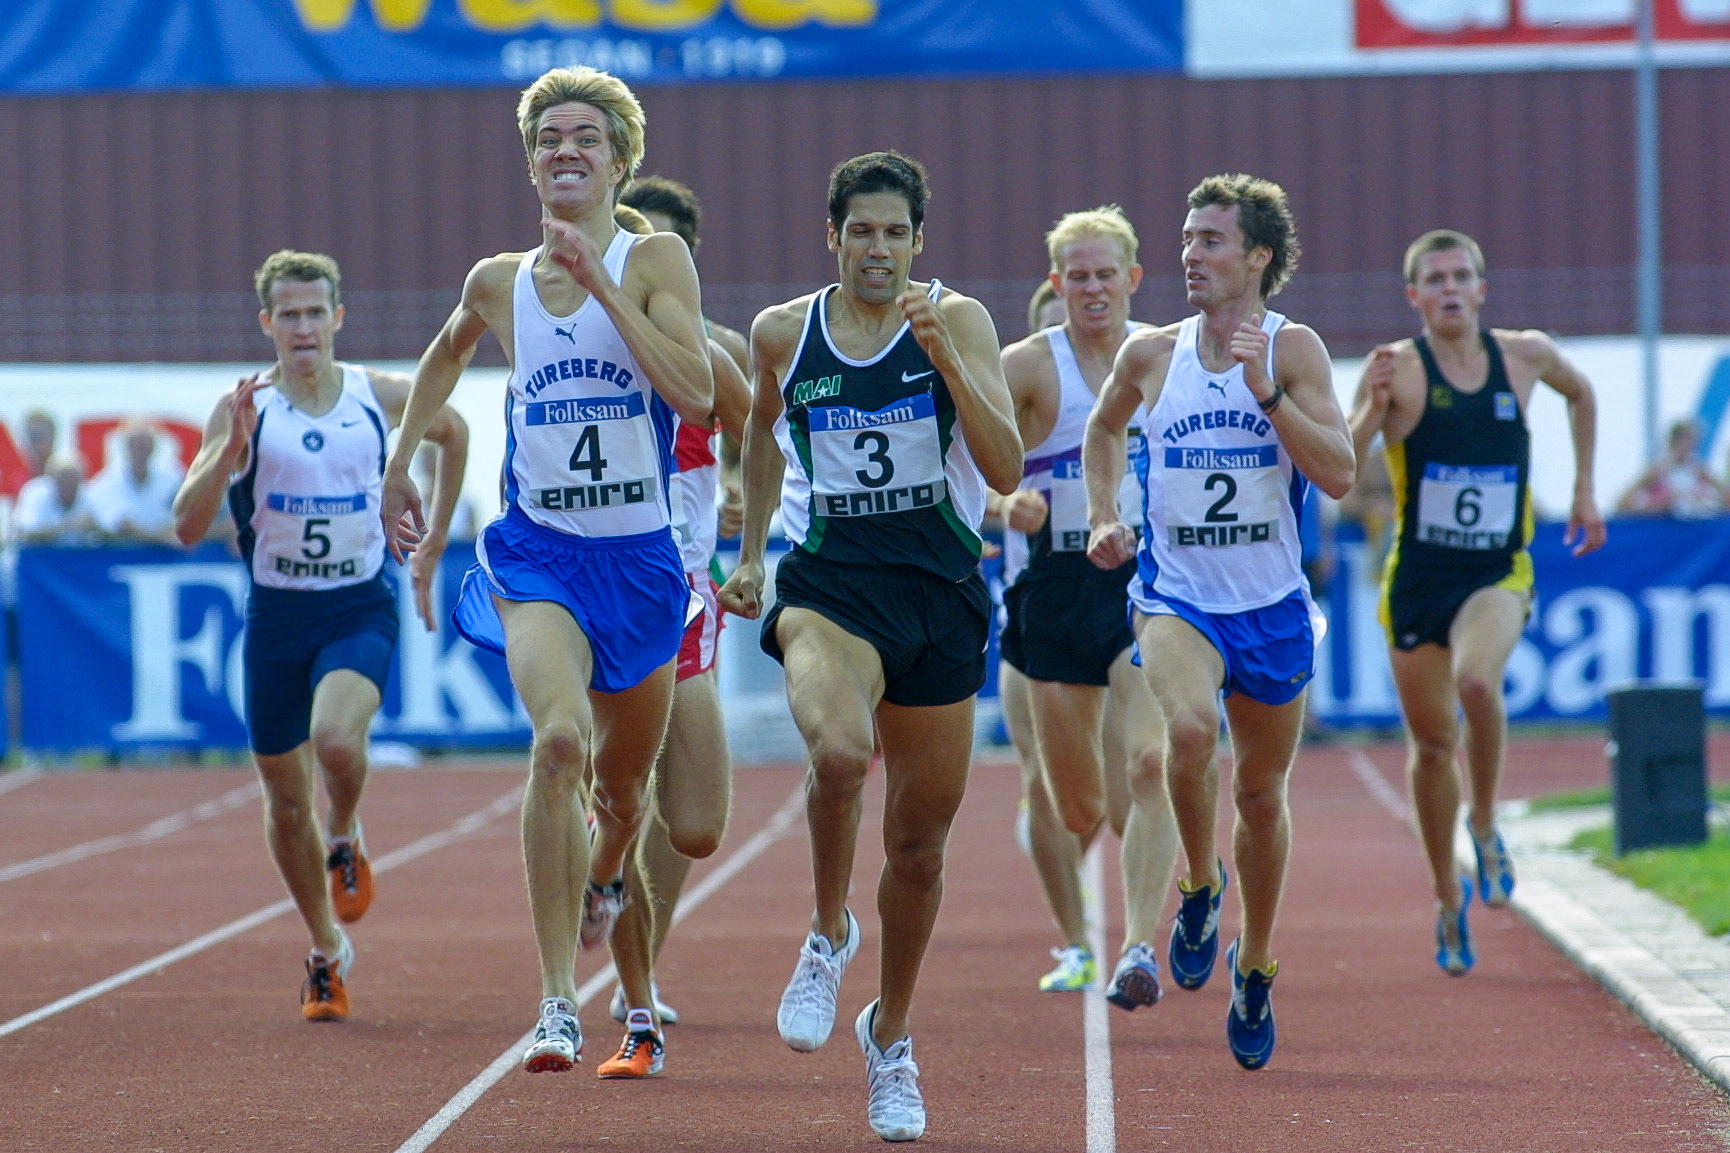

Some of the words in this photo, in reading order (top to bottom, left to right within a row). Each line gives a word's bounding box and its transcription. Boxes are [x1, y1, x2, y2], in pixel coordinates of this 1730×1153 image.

[525, 358, 634, 399] TUREBERG
[793, 374, 842, 406] MAI
[543, 401, 629, 424] Folksam
[825, 404, 915, 430] Folksam
[1162, 409, 1272, 445] TUREBERG
[569, 424, 608, 482] 4
[853, 430, 895, 489] 3
[1181, 448, 1261, 469] Folksam
[541, 480, 645, 510] eniro
[825, 484, 934, 516] eniro
[1204, 472, 1239, 523] 2
[1455, 487, 1482, 527] 6
[301, 518, 331, 559] 5
[1177, 522, 1270, 547] eniro
[275, 556, 356, 579] eniro
